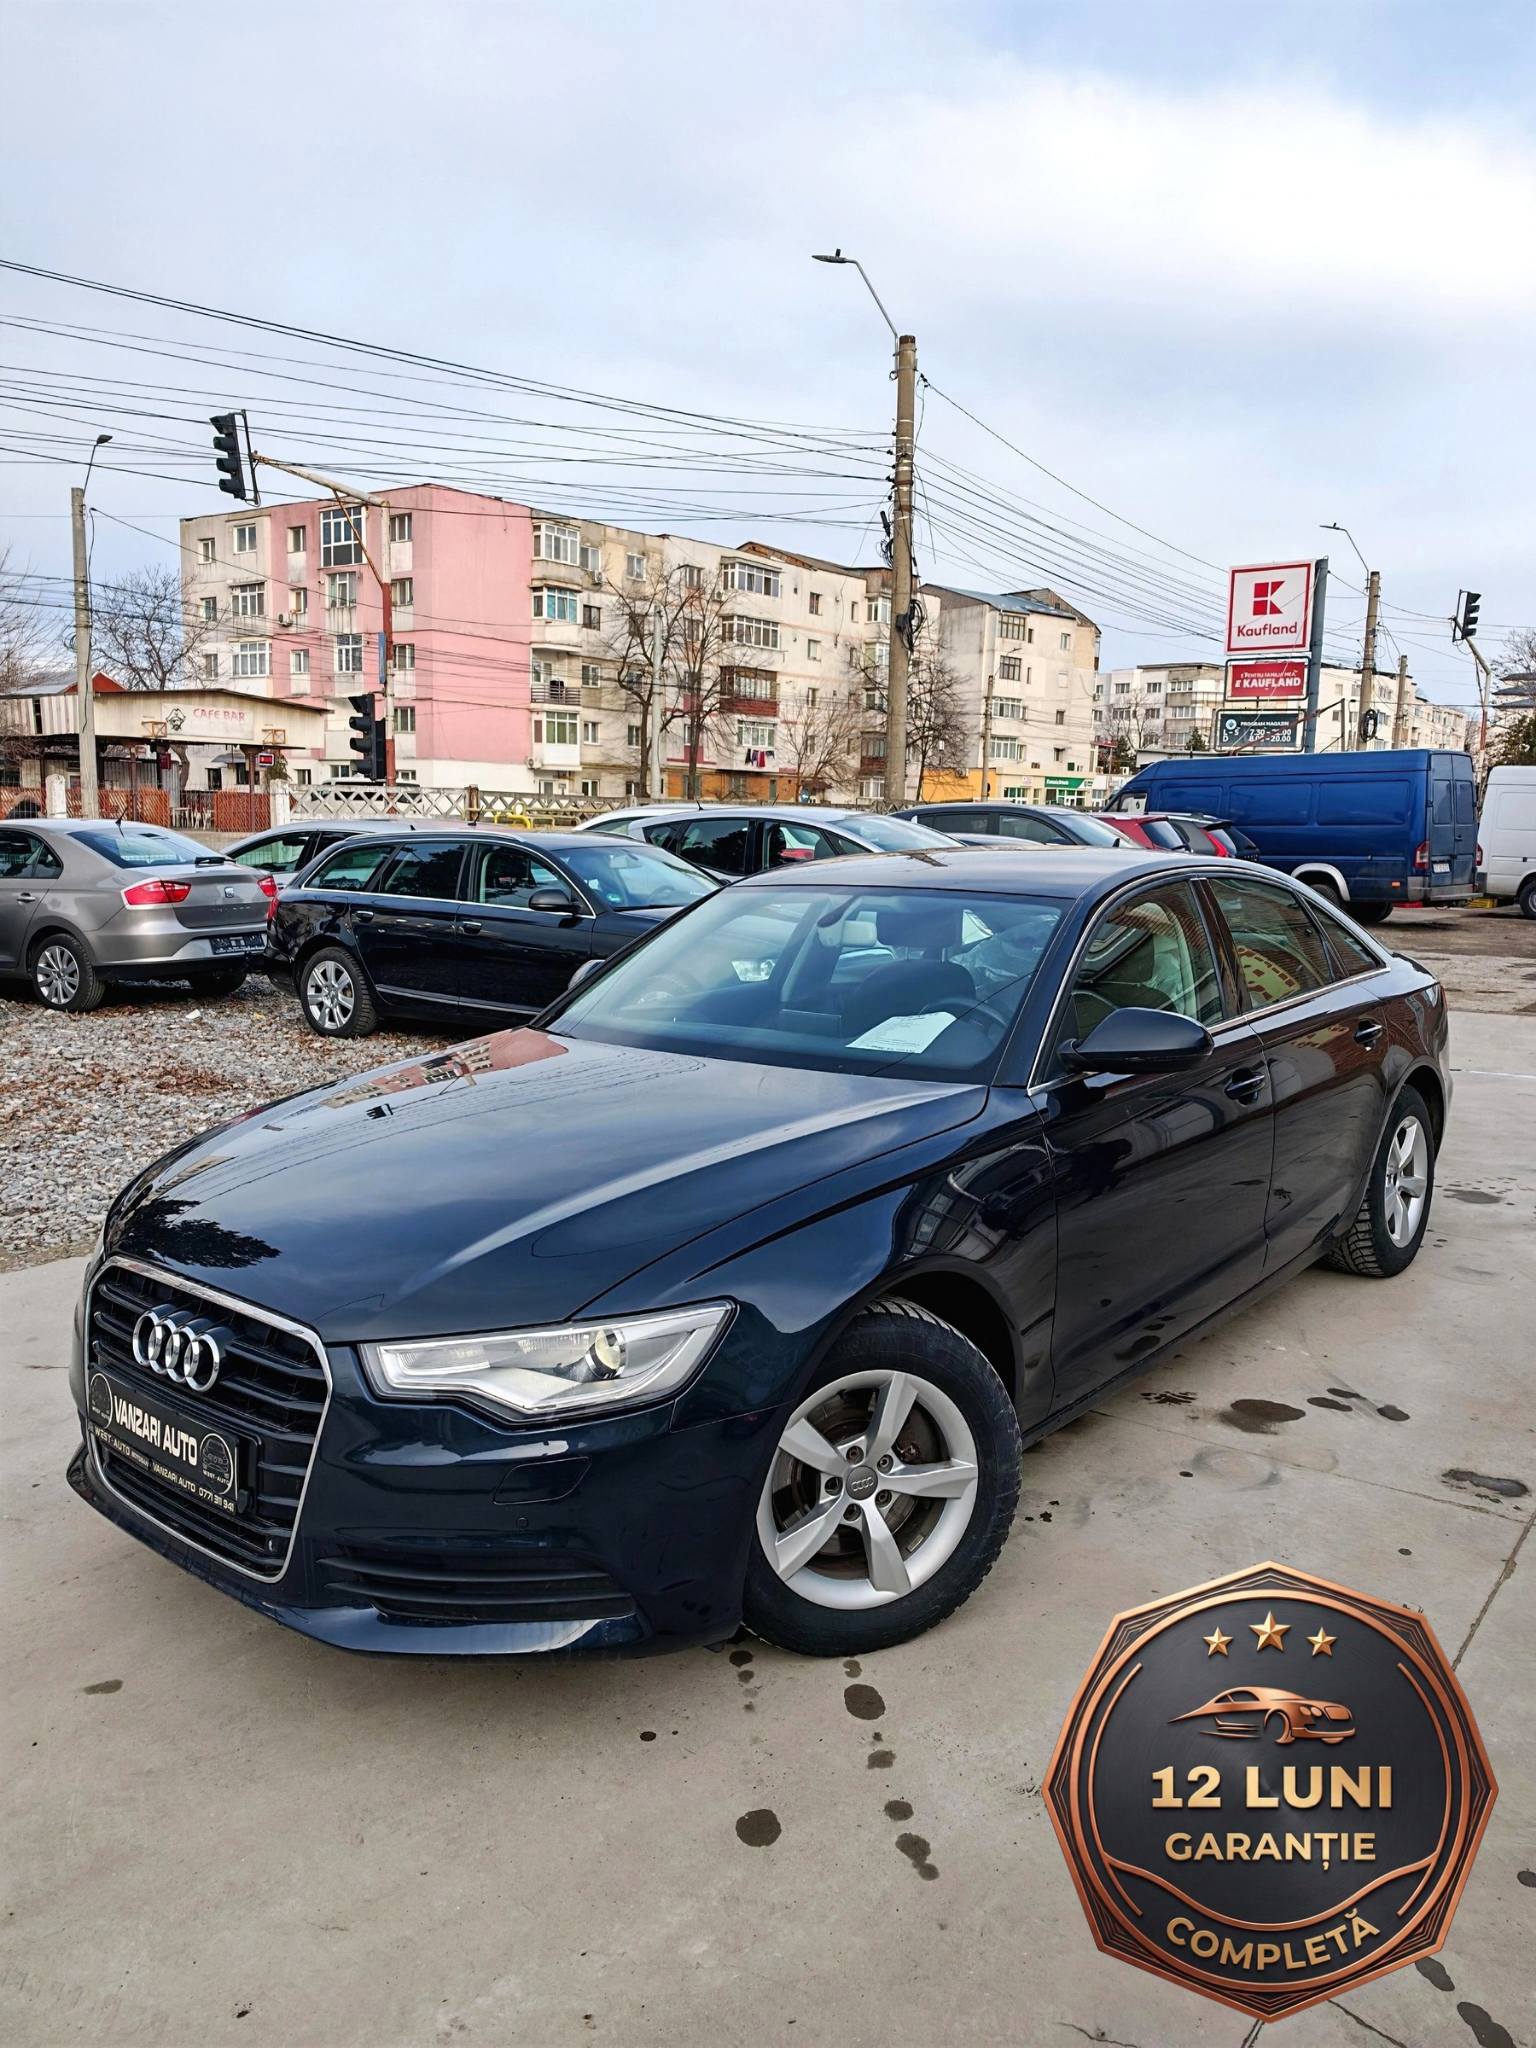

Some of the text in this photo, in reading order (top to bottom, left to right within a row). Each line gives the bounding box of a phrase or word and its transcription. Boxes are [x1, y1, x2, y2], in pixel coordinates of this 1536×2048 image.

[1237, 621, 1298, 637] Kaufland
[1243, 677, 1301, 688] KAUFLAND
[193, 708, 245, 721] CAFE BAR
[114, 1395, 198, 1467] VANZARI AUTO
[152, 1461, 177, 1483] VANZARI
[178, 1477, 196, 1493] AUTO
